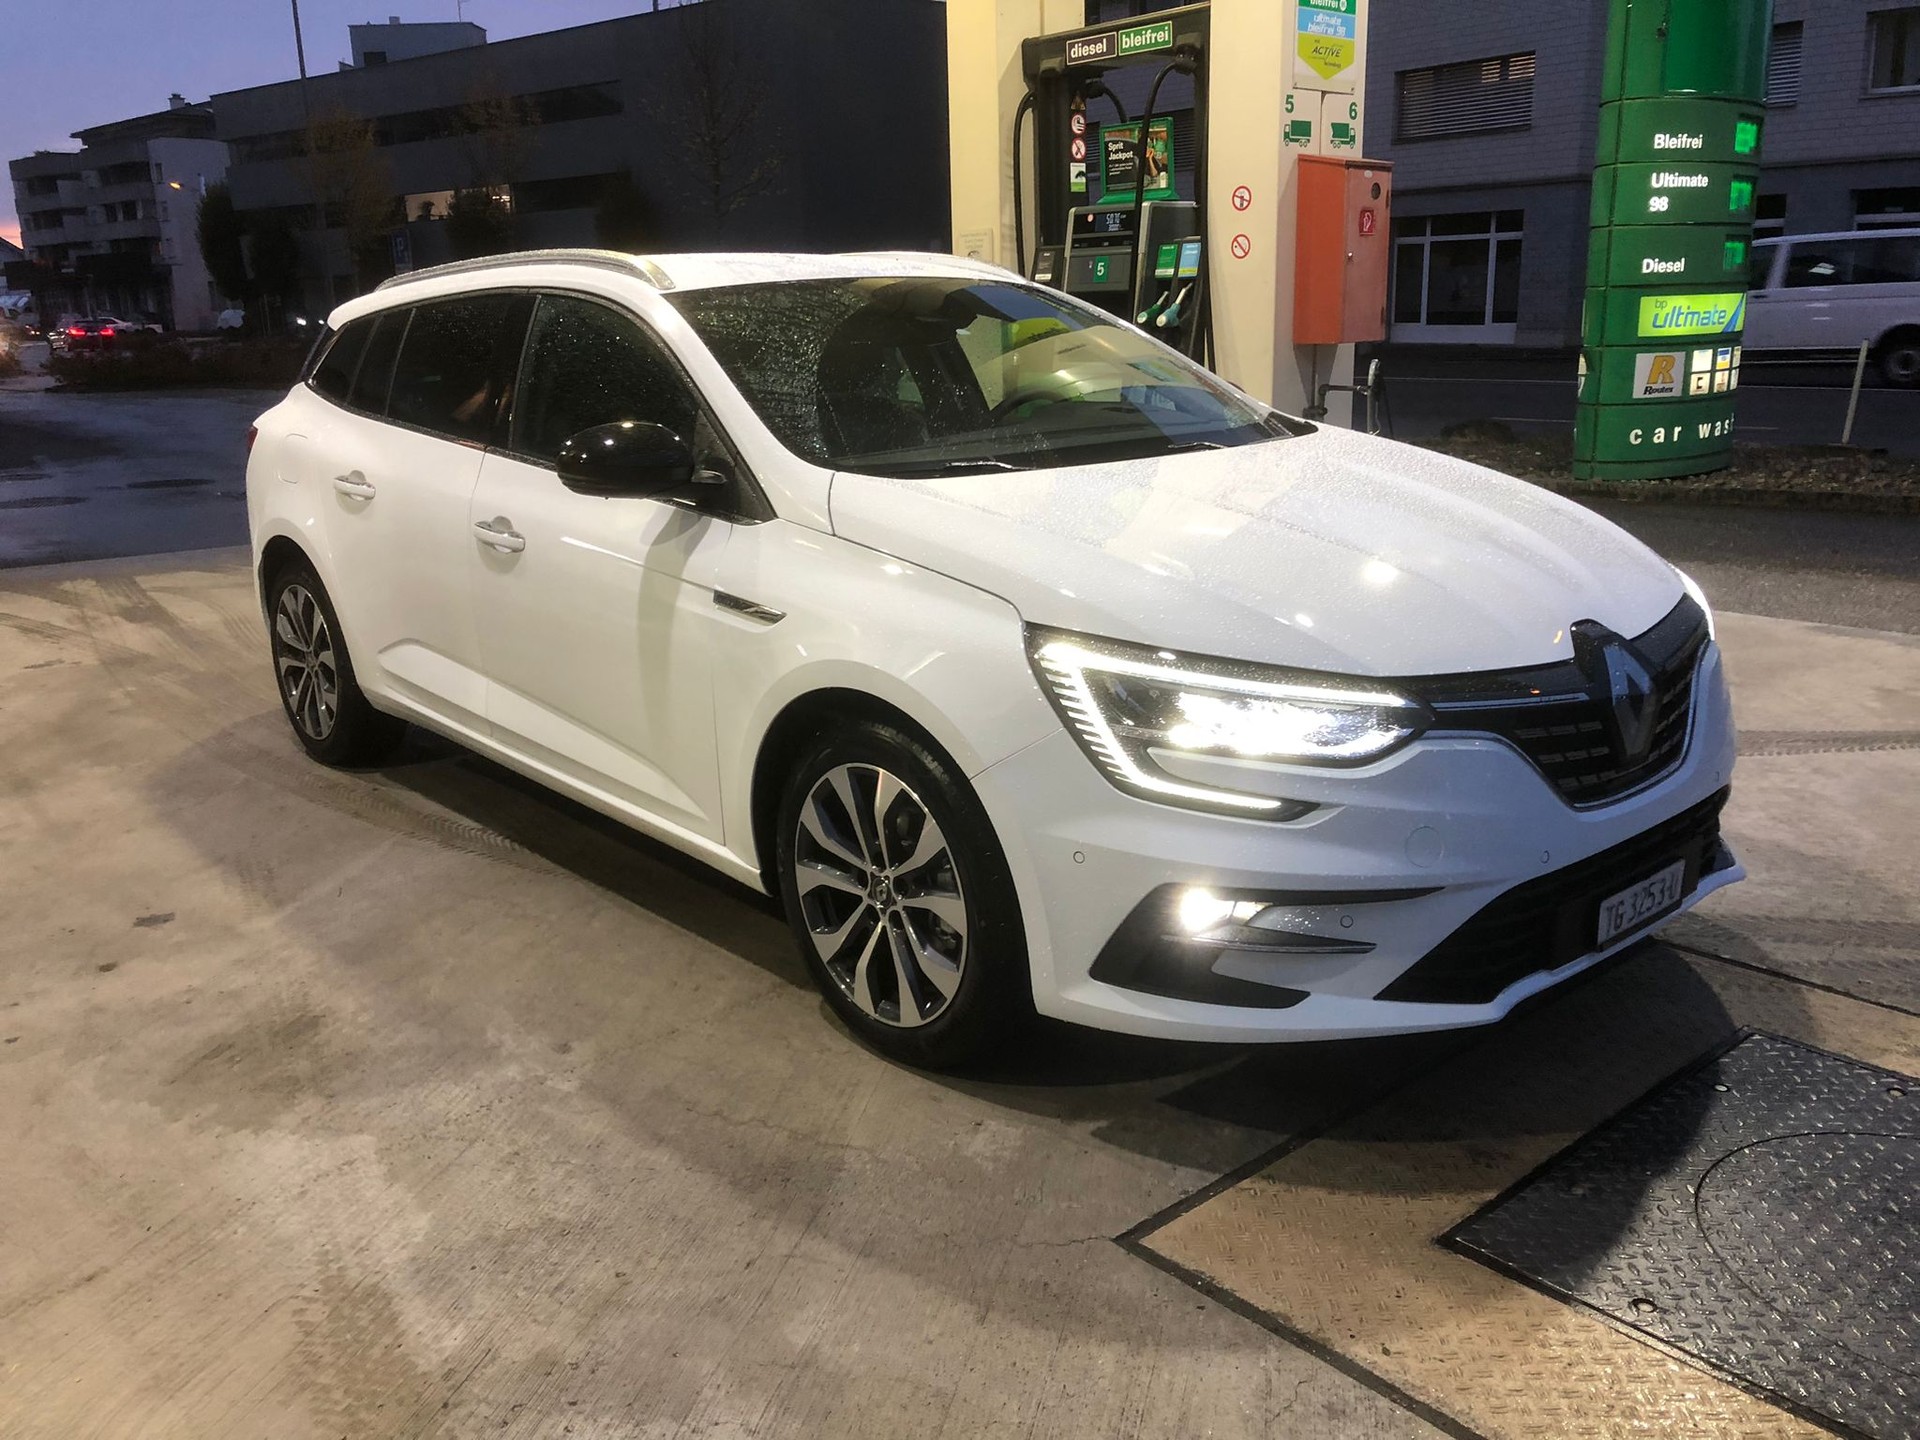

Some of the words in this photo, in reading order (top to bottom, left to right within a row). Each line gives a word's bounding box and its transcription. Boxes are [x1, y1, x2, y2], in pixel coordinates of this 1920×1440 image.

[1122, 26, 1169, 49] bleifrei
[1070, 38, 1107, 59] diesel
[1311, 45, 1342, 58] ACTIVE
[1284, 94, 1295, 113] 5
[1348, 102, 1358, 120] 6
[1108, 141, 1124, 152] Sprit
[1653, 133, 1703, 149] Bleifrei
[1108, 150, 1134, 161] Jackpot
[1651, 172, 1709, 188] Ultimate
[1649, 196, 1669, 212] 98
[1096, 262, 1105, 276] 5
[1641, 257, 1686, 273] Diesel
[1654, 298, 1668, 310] bp
[1652, 304, 1727, 329] ultimate
[1629, 425, 1683, 445] car
[1606, 900, 1626, 935] TG
